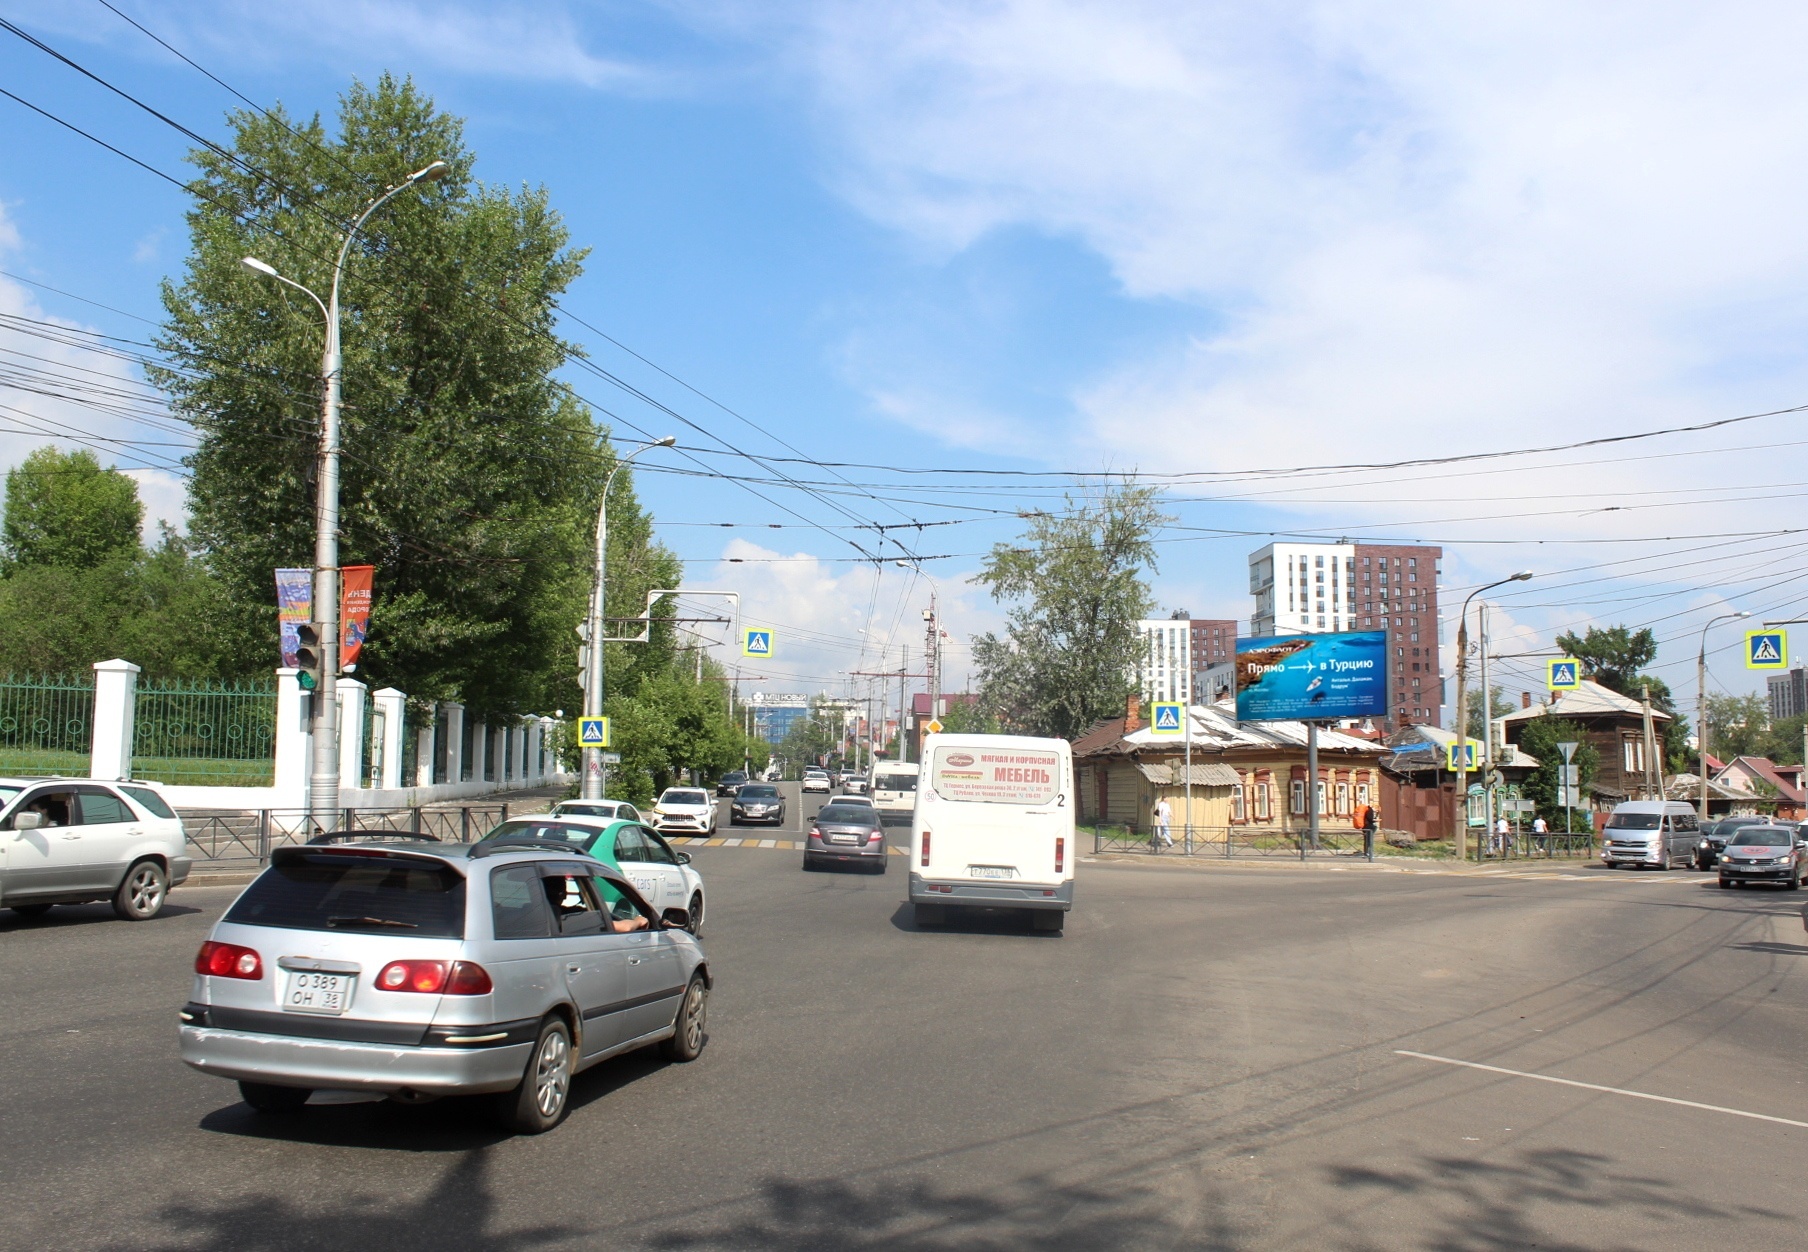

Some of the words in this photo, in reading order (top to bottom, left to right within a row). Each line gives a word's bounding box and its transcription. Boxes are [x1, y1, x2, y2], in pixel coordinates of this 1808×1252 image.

[1248, 663, 1285, 676] Прямо
[1320, 662, 1327, 671] в
[1329, 659, 1373, 673] Турцию
[781, 693, 807, 701] НОВЫЙ
[981, 754, 1008, 763] МЯГКАЯ
[1016, 756, 1055, 765] КОРПУСНАЯ
[994, 767, 1050, 784] МЕБЕЛЬ
[927, 792, 935, 801] 50
[1057, 793, 1065, 807] 2
[292, 991, 314, 1005] ОН
[324, 994, 337, 1004] 38
